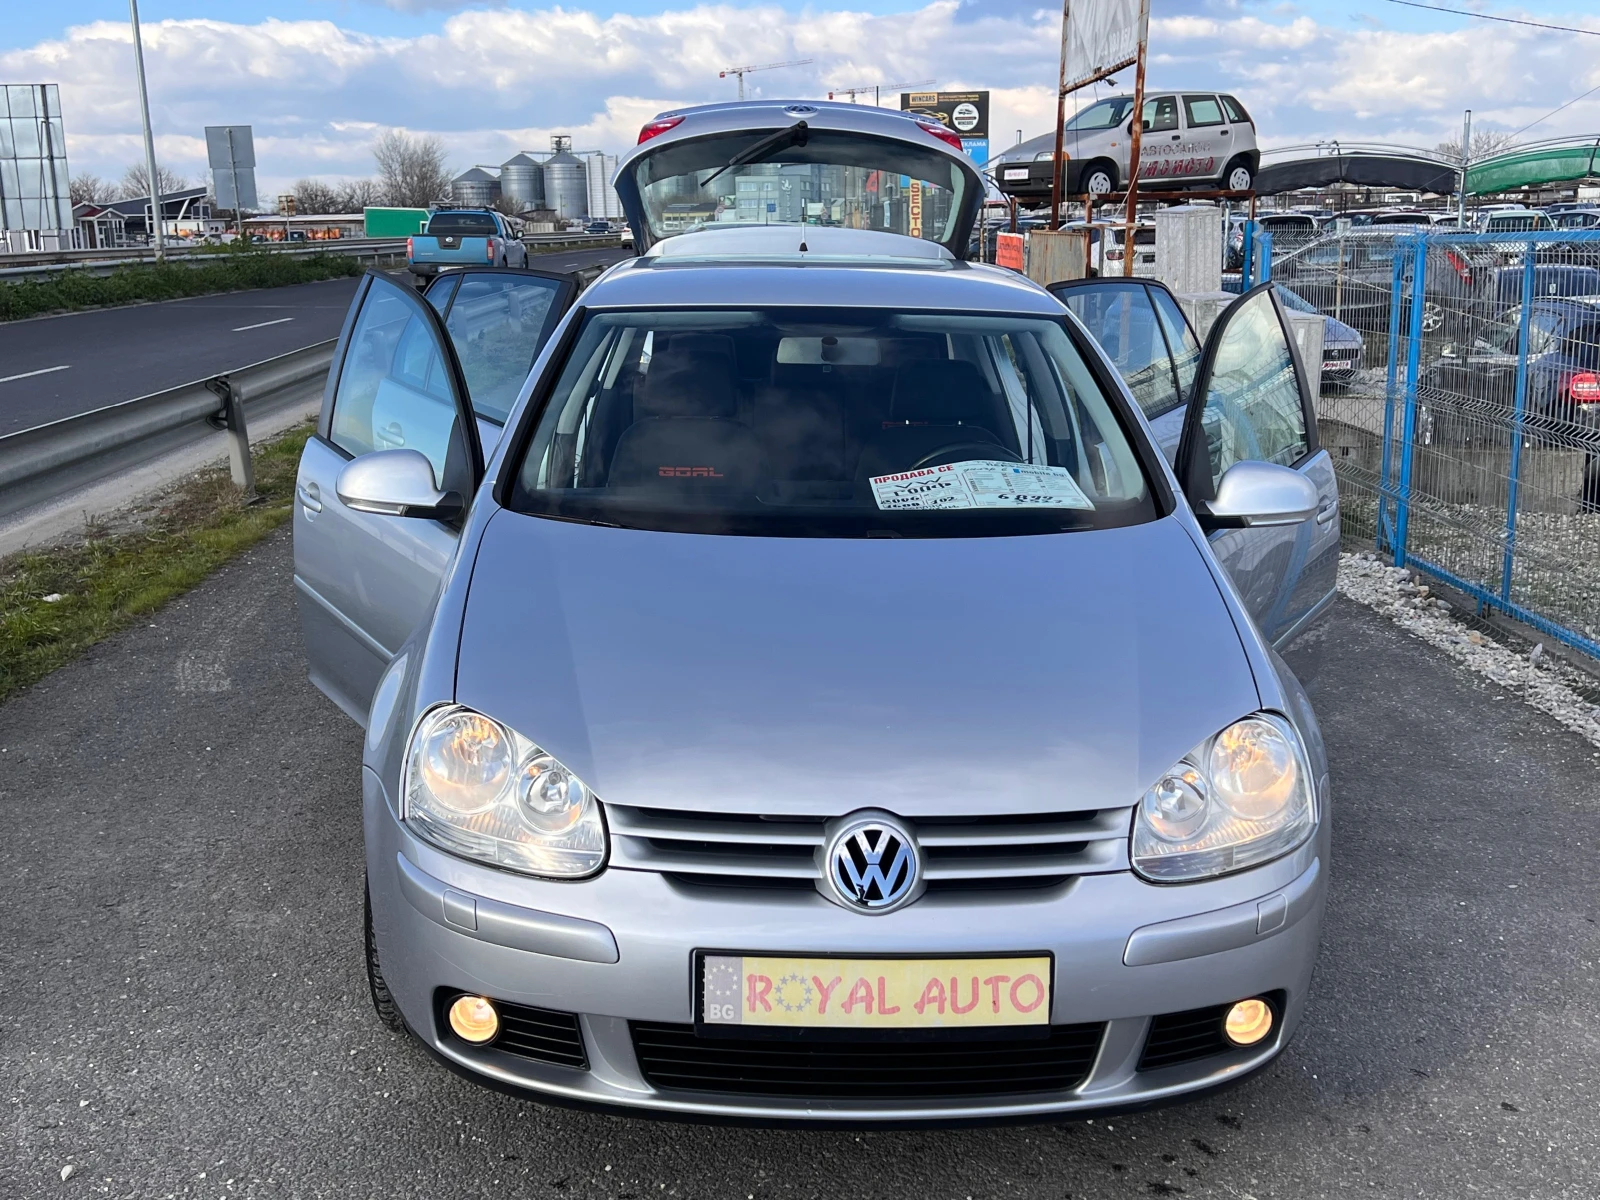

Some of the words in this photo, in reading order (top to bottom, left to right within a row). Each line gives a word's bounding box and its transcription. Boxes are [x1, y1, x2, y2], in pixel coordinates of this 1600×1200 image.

[911, 95, 936, 103] WINCARS
[658, 466, 724, 477] GOAL
[873, 468, 935, 484] ПРОДАВА
[937, 464, 955, 473] СЕ
[895, 476, 942, 489] VW
[746, 973, 901, 1015] ROYAL
[913, 973, 1046, 1015] AUTO
[709, 1003, 735, 1020] BG
